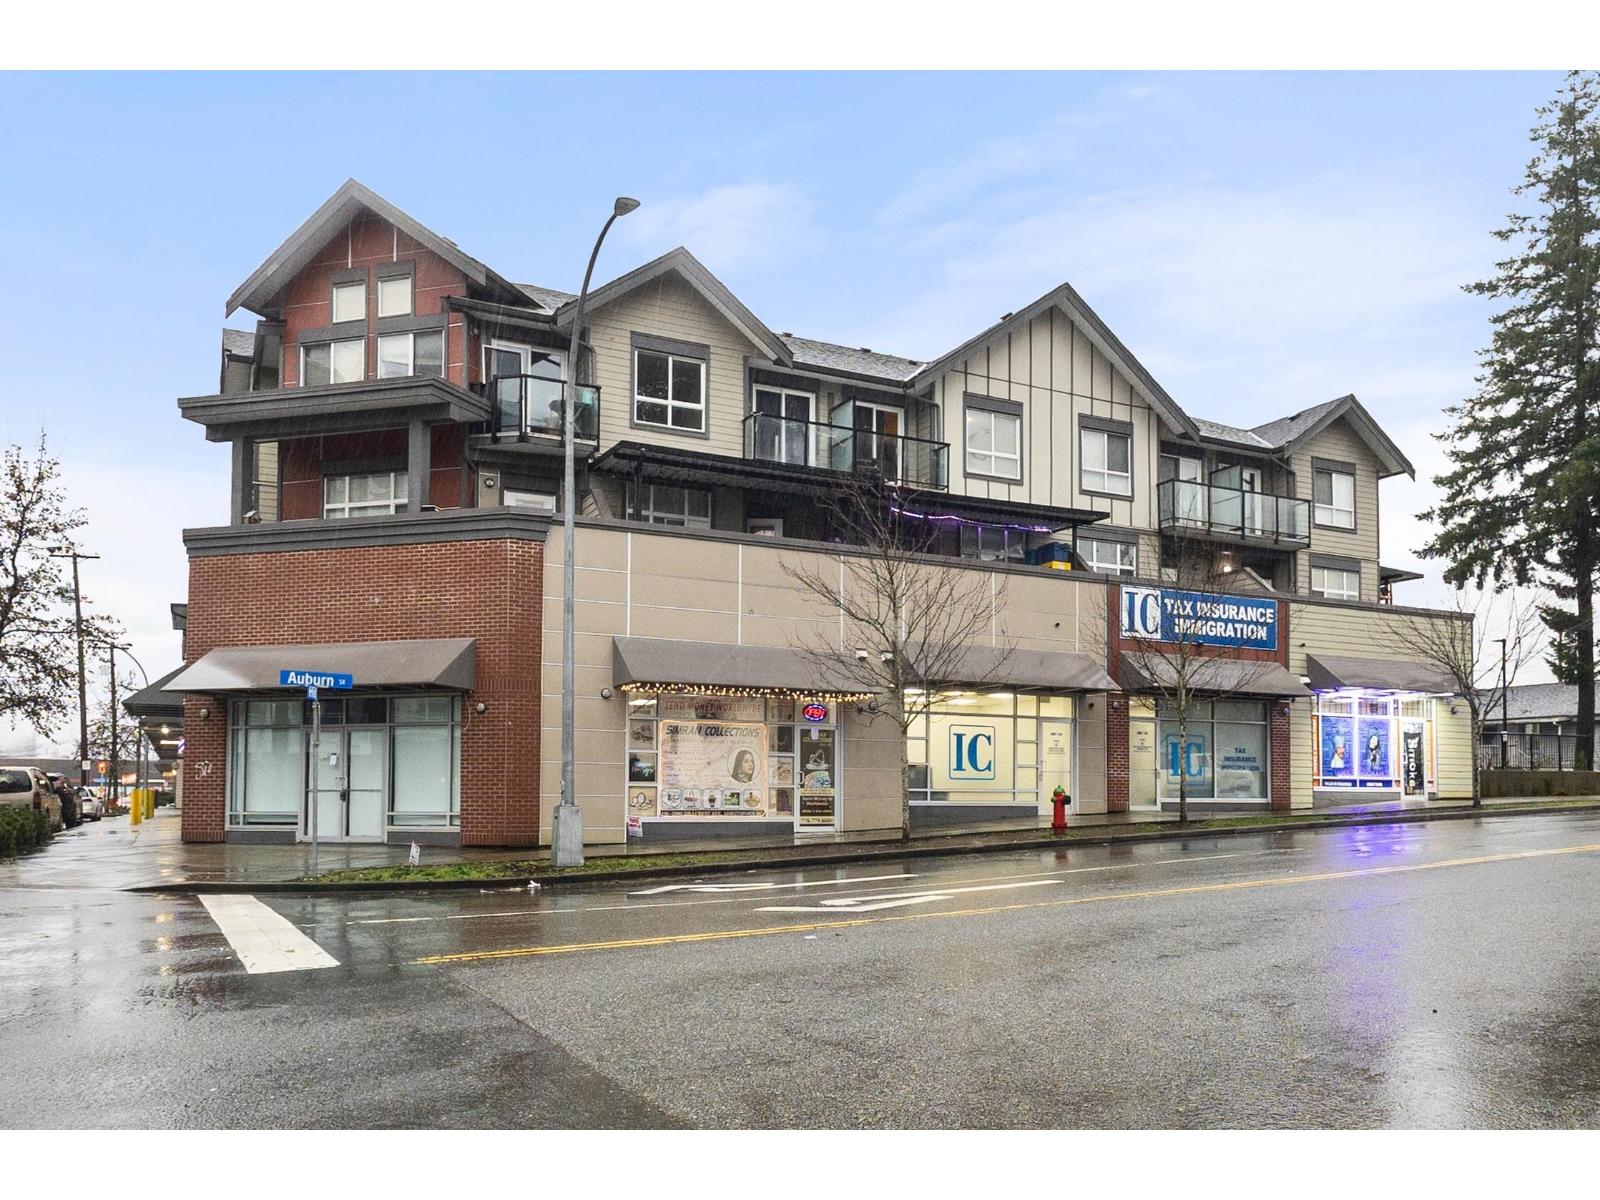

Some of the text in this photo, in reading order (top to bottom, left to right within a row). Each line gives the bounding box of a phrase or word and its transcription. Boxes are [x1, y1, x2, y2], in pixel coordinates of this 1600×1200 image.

[1124, 591, 1160, 634] IC
[1164, 598, 1275, 623] TAX INSURANCE
[287, 671, 335, 688] Auburn
[688, 700, 715, 712] MONEY
[665, 725, 761, 738] SIMRAN COLLECTIONS
[952, 732, 992, 772] IC
[1169, 742, 1203, 777] IC
